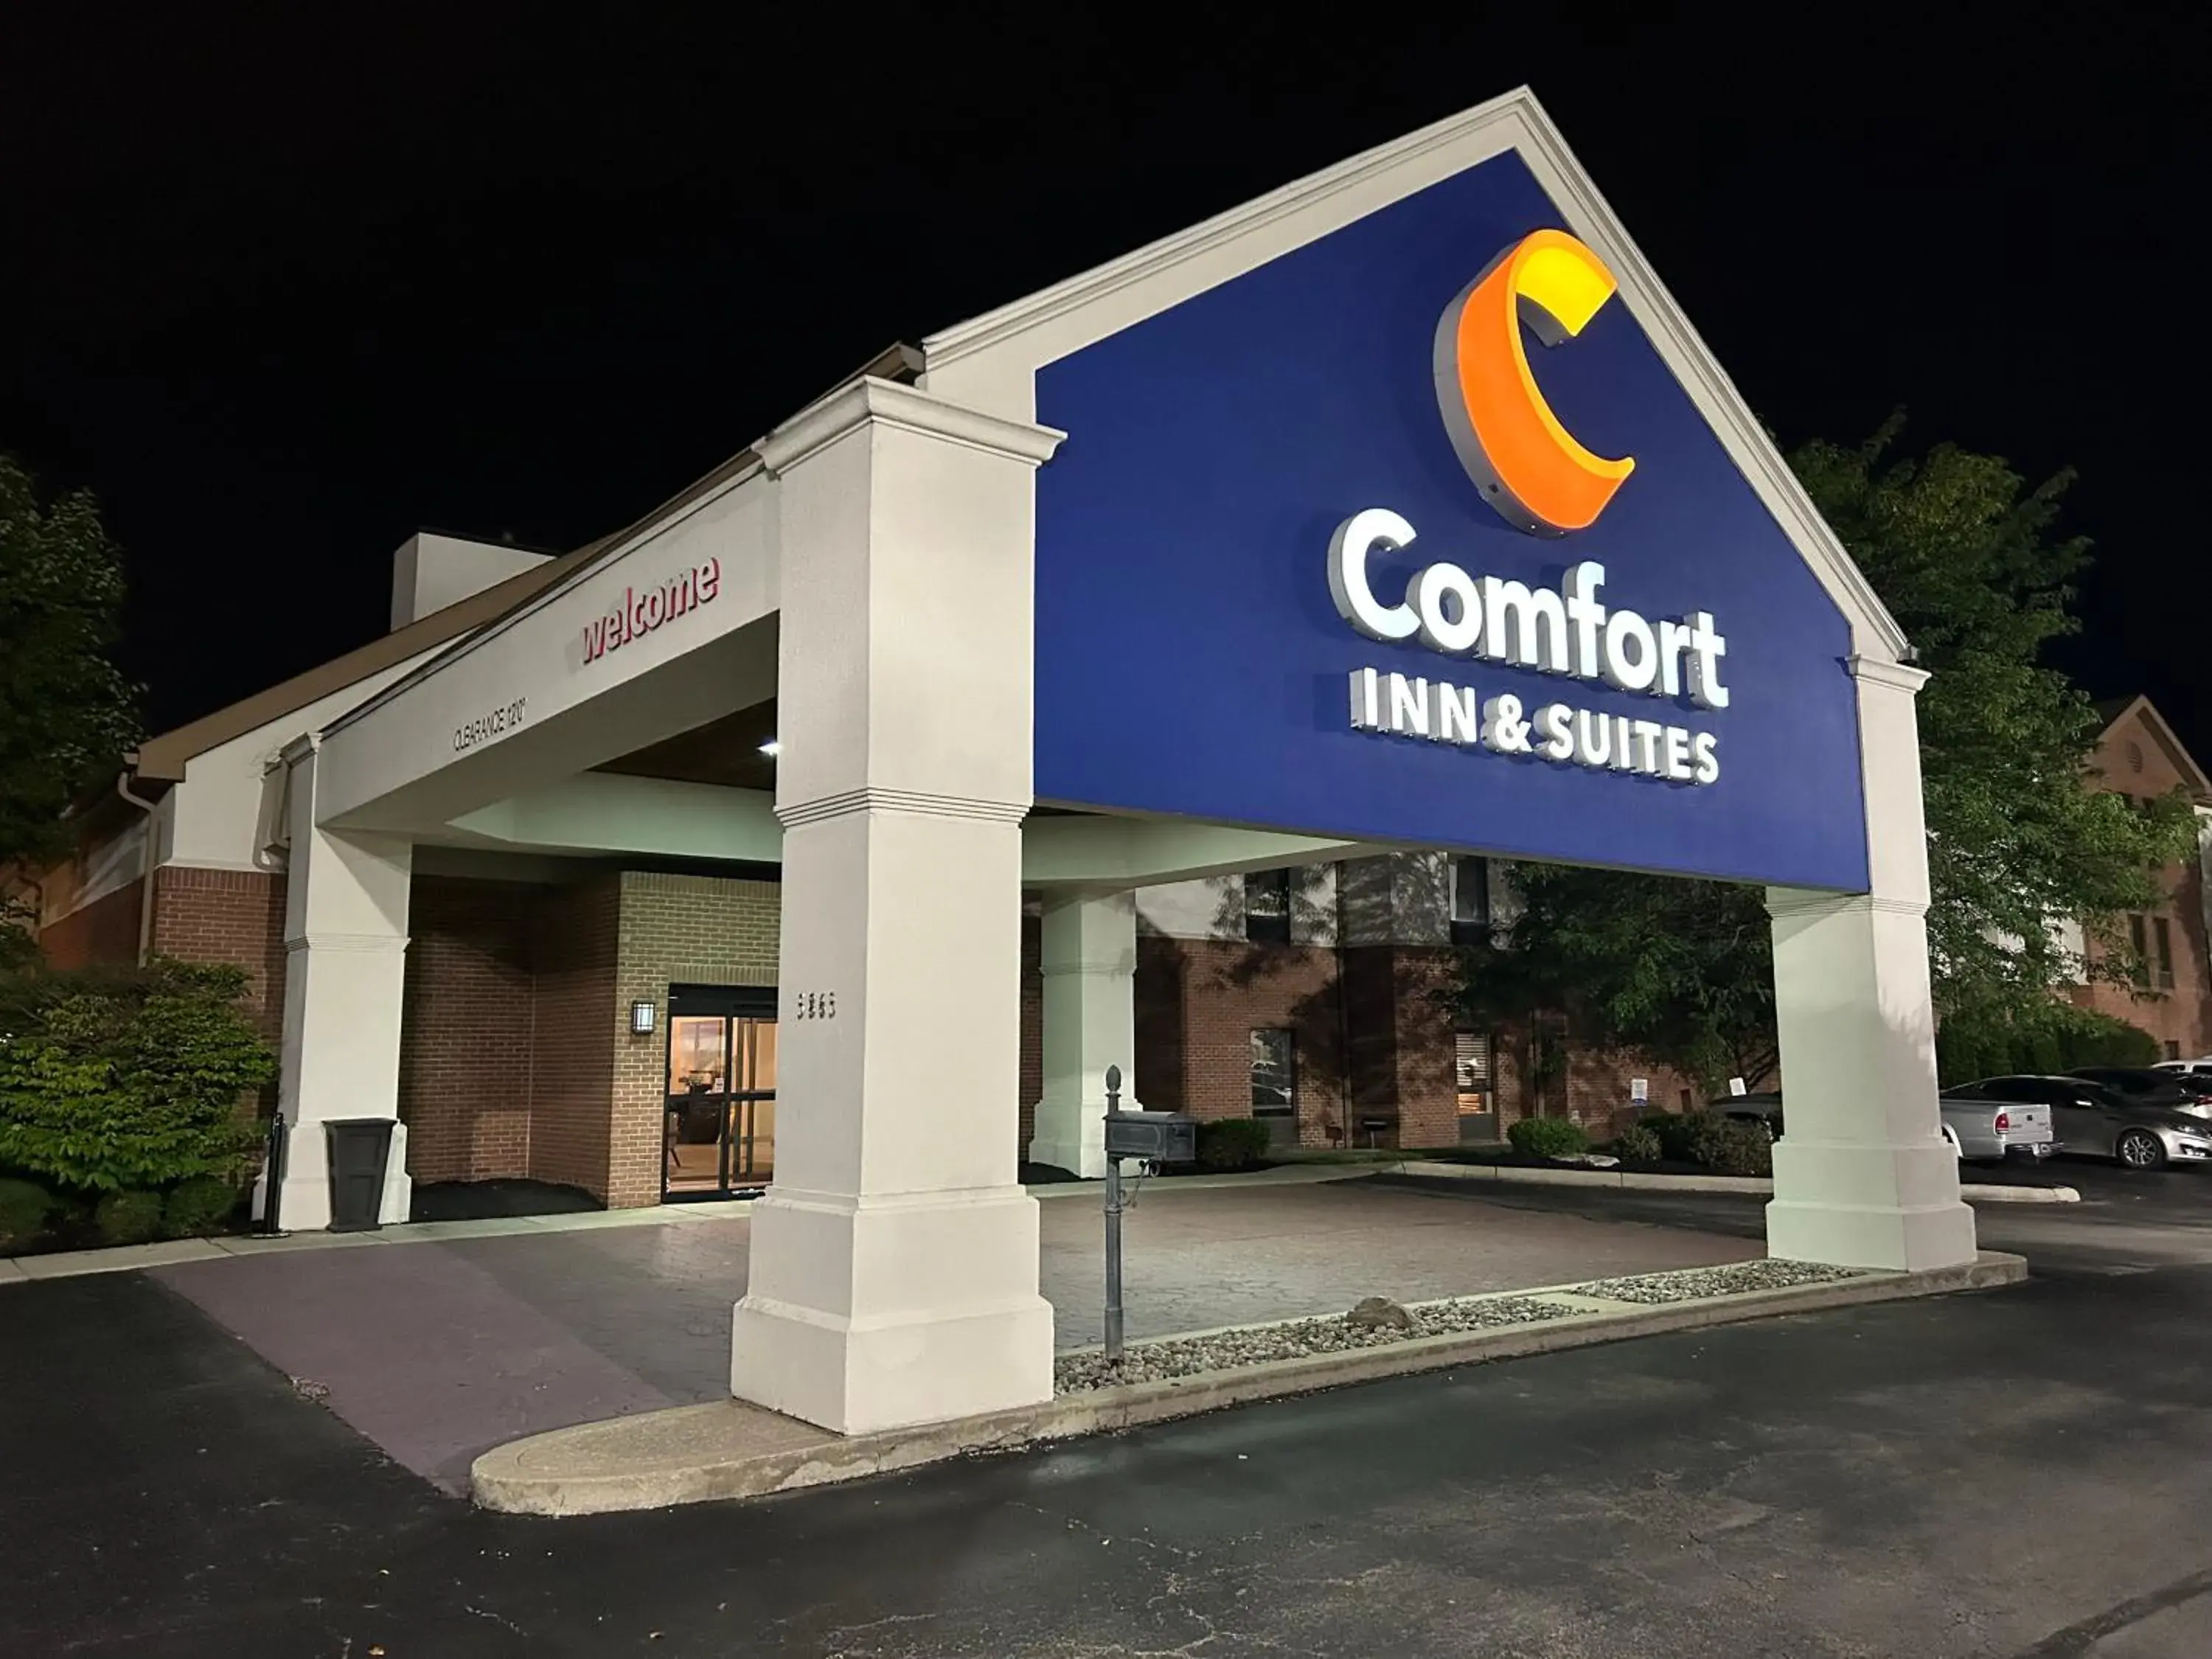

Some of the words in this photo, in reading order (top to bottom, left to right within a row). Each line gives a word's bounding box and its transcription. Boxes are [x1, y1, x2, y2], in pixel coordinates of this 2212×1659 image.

[582, 557, 720, 665] welcome
[1328, 508, 1728, 709] Comfort
[454, 707, 504, 751] CLEARANCE
[1349, 667, 1476, 745] INN
[1481, 694, 1533, 754] &
[1534, 702, 1719, 784] SUITES
